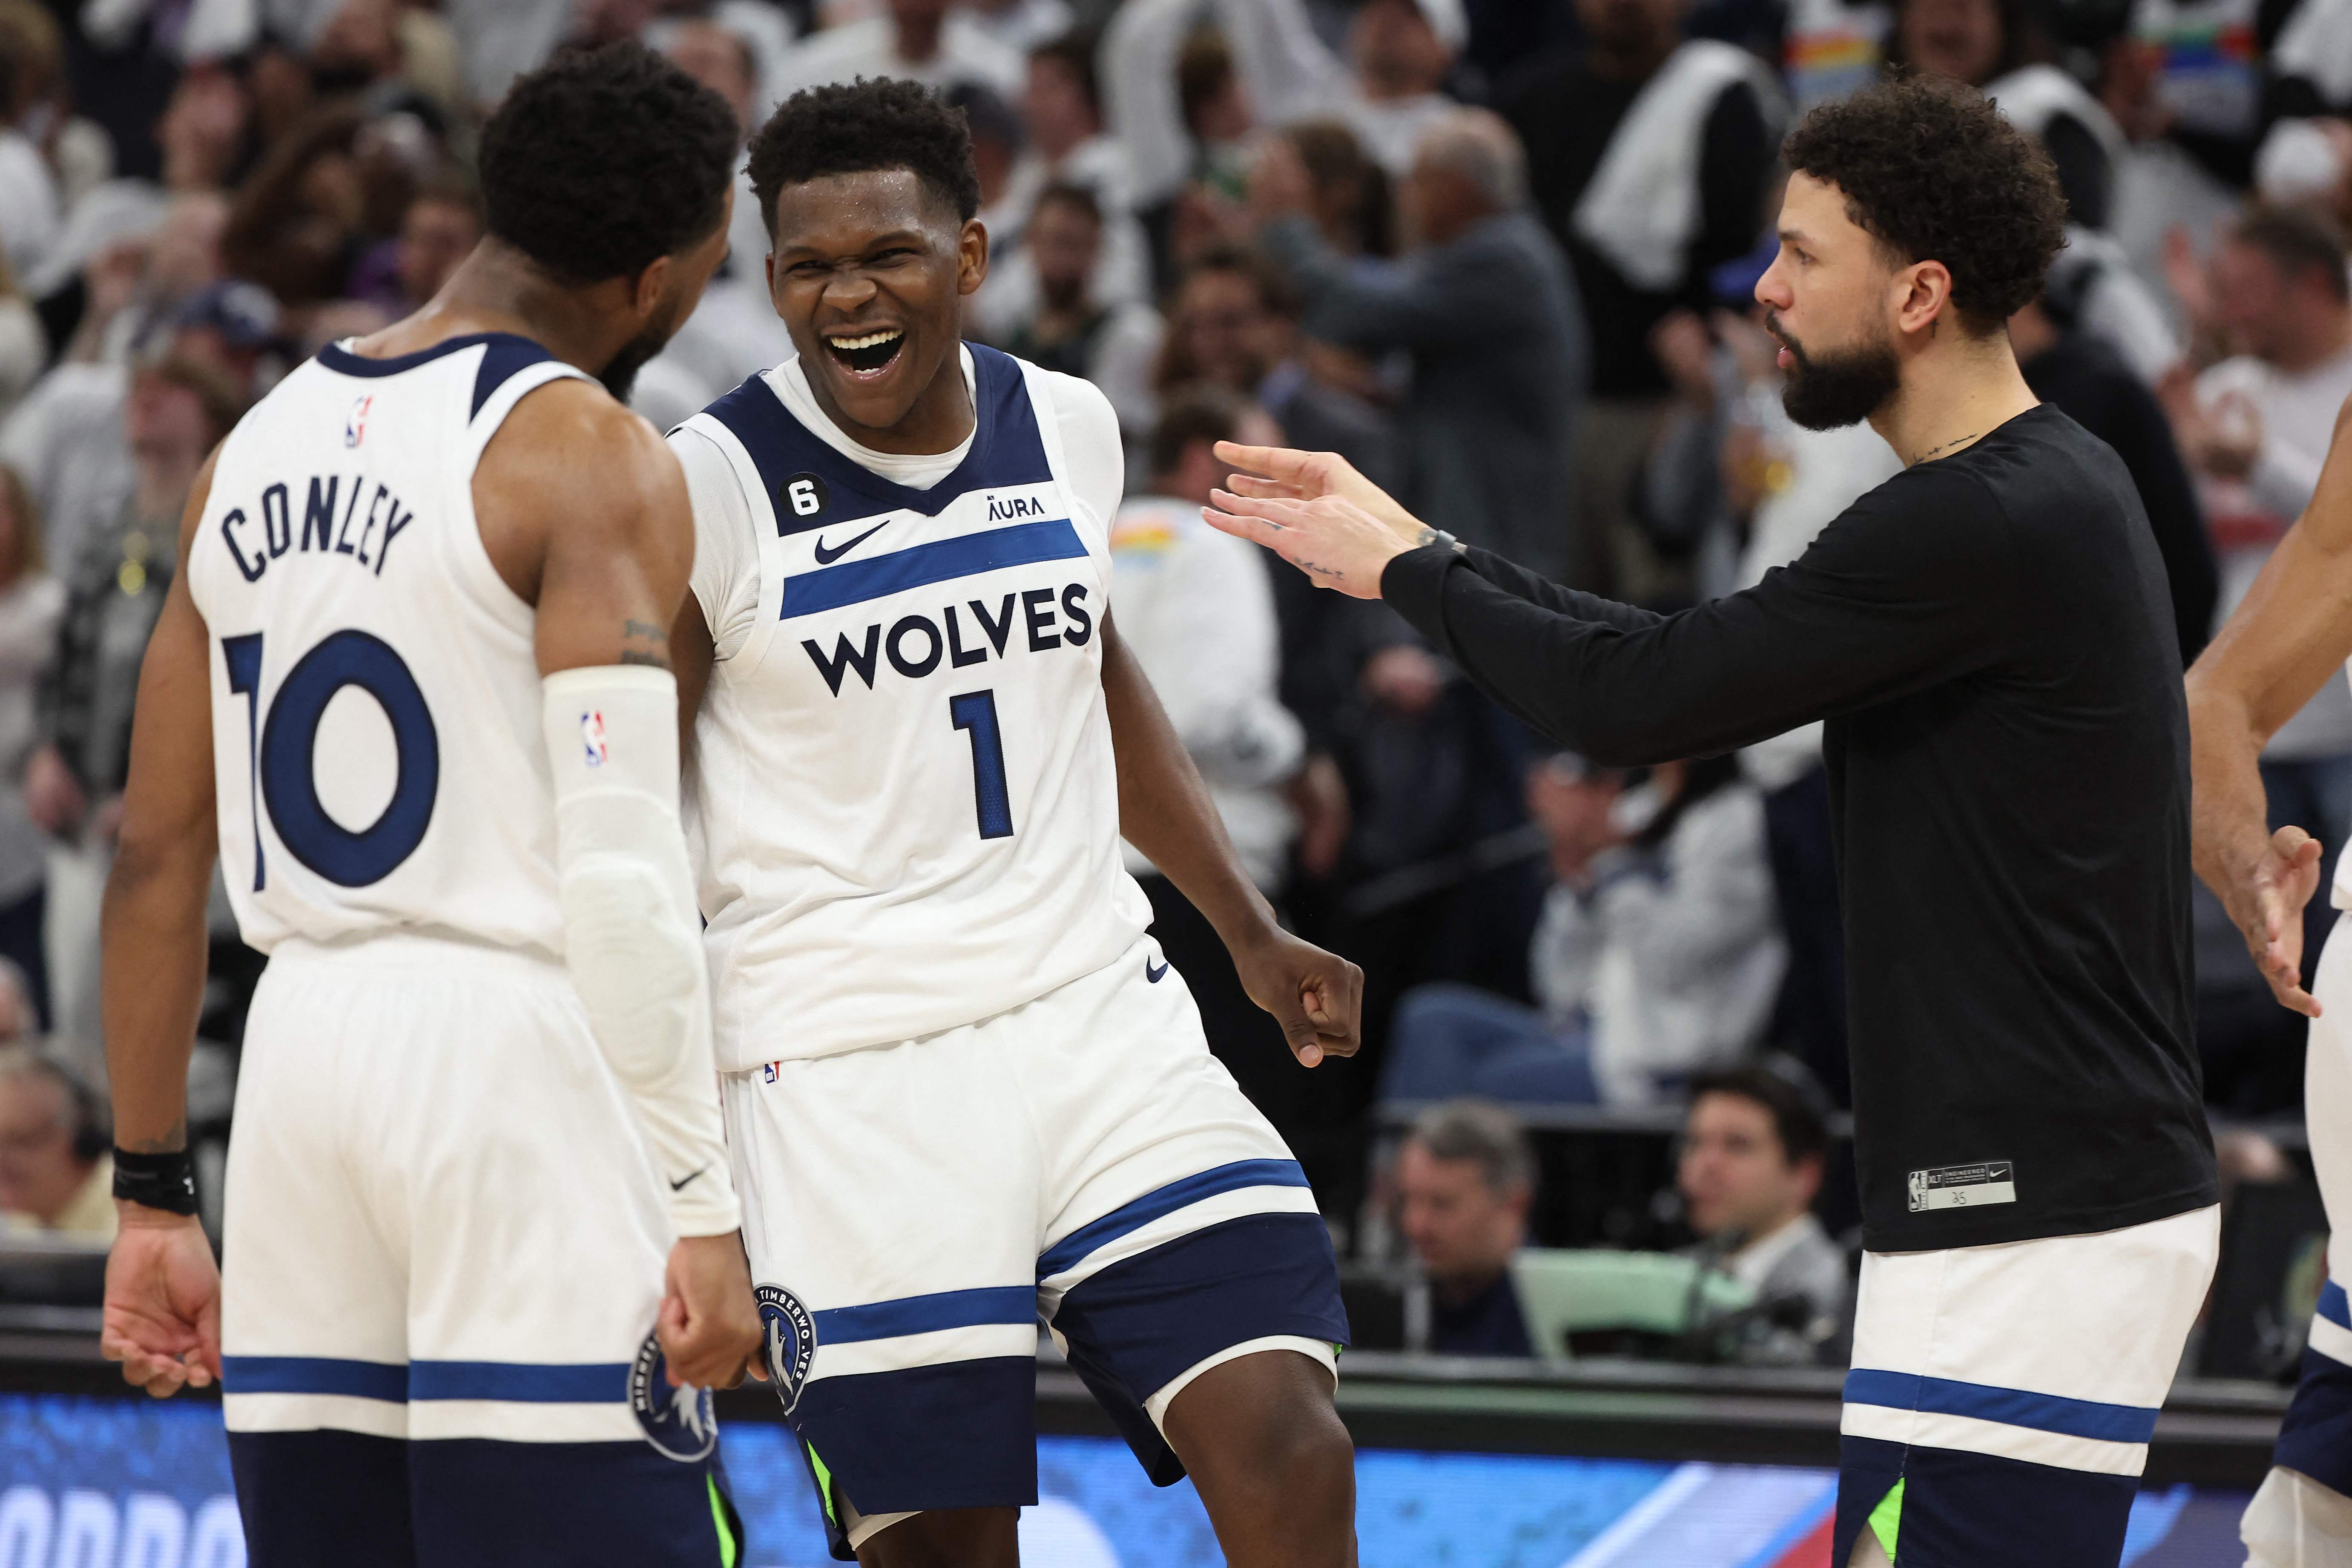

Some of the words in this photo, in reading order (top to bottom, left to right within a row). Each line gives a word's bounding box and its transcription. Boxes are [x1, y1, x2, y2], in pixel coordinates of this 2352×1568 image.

[221, 475, 413, 583] CONLEY
[788, 479, 820, 517] 6
[801, 583, 1091, 698] WOLVES
[221, 628, 439, 893] 10
[949, 688, 1014, 840] 1
